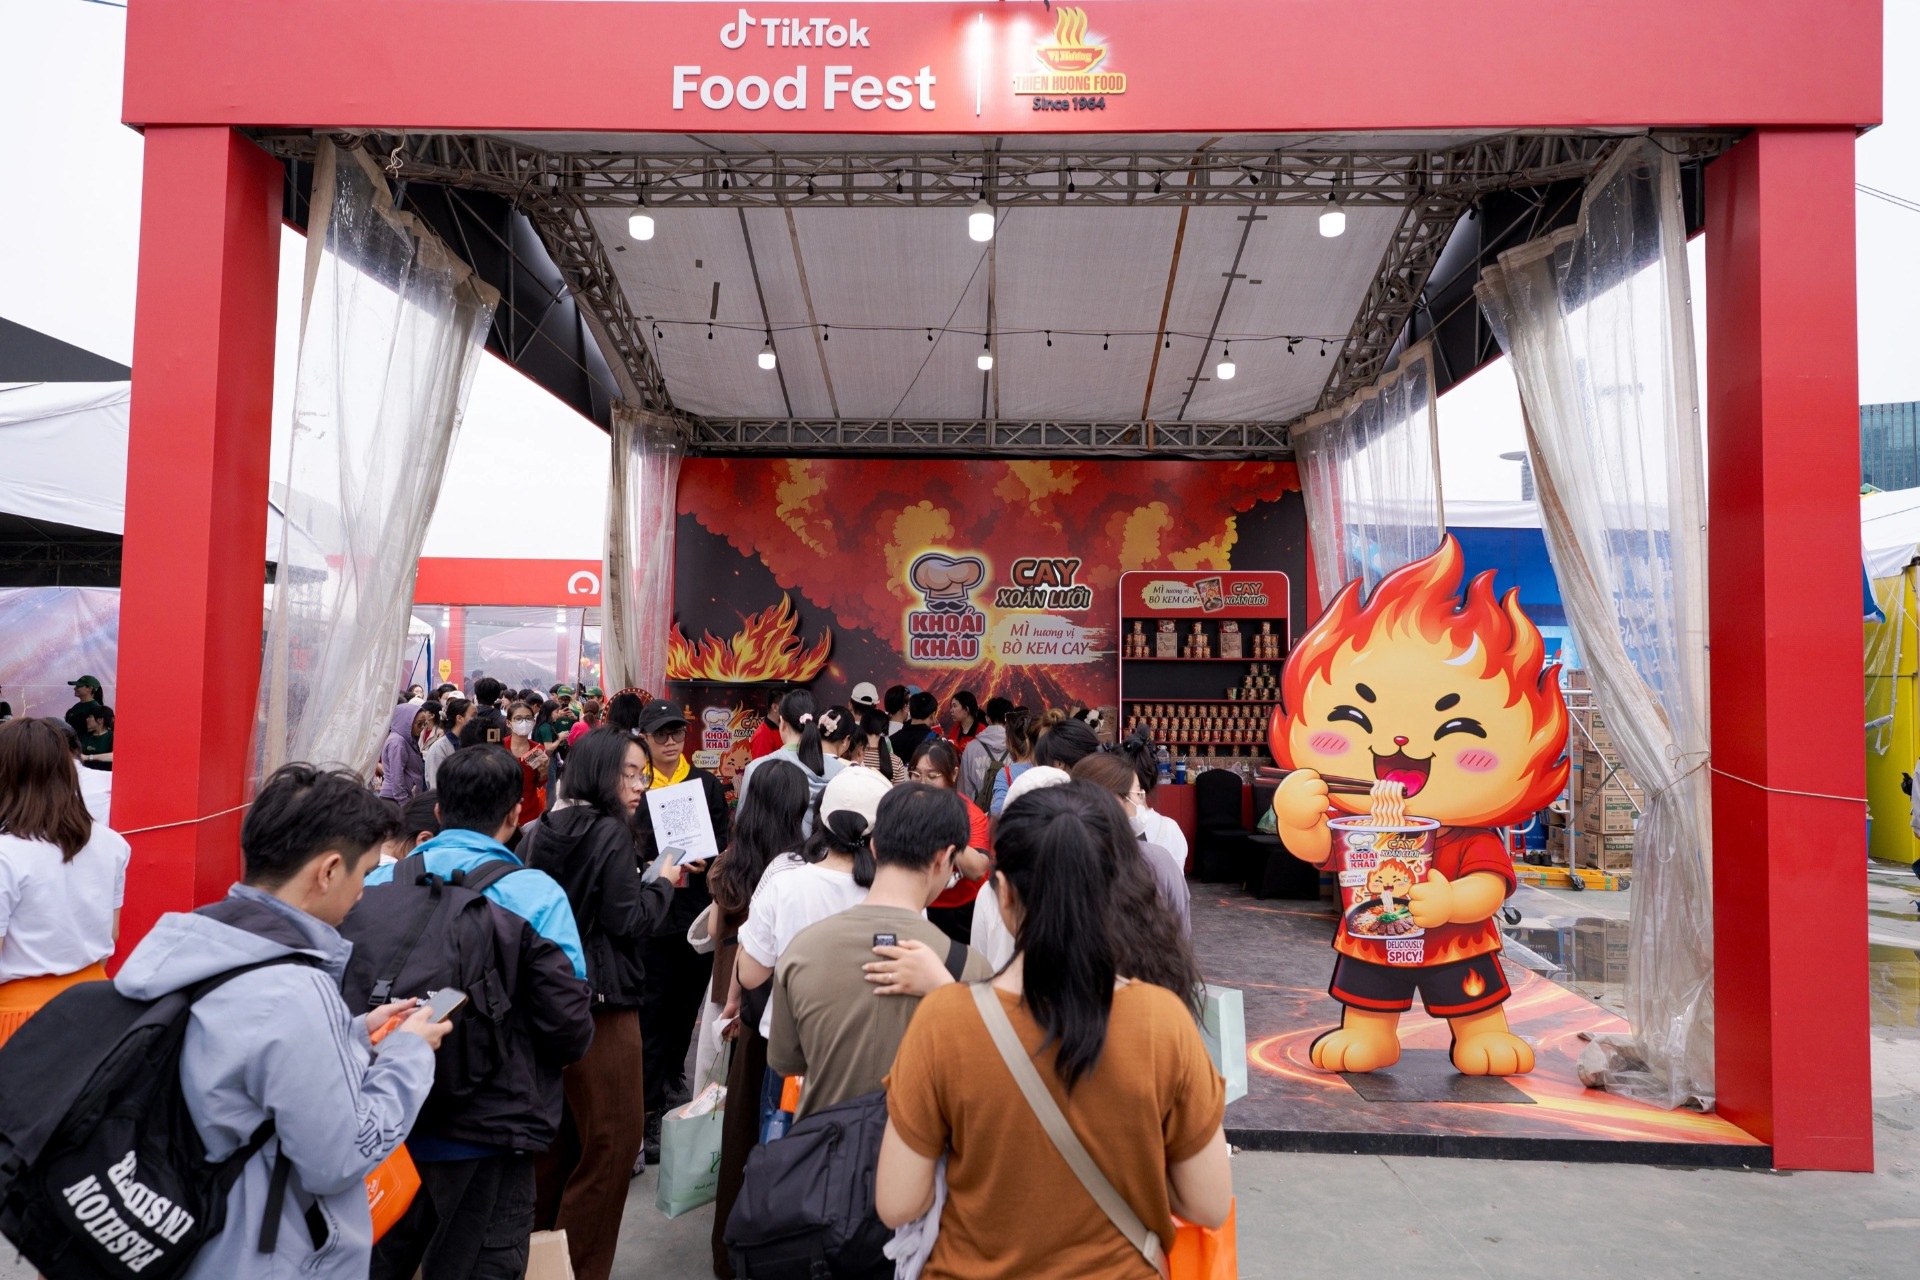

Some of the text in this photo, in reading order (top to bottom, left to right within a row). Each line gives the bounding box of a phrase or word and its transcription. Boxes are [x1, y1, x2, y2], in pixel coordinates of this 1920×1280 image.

[761, 17, 870, 48] TikTok
[672, 63, 936, 111] Food Fest
[1016, 75, 1124, 91] THIEN HUONG FOOD
[1033, 96, 1105, 111] Since 1964
[1013, 559, 1080, 587] CAY
[998, 587, 1092, 608] XOẮN LƯỠI
[1232, 583, 1262, 595] CAY
[1162, 595, 1180, 604] KEM
[1182, 595, 1197, 604] CAY
[911, 608, 984, 635] KHOÁI
[1033, 628, 1063, 639] hương
[1065, 627, 1075, 639] vị
[912, 632, 978, 658] KHẨU
[1001, 638, 1090, 656] BÒ KEM CAY
[1387, 839, 1415, 849] CAY
[1387, 940, 1423, 949] DELICIOUSLY
[1389, 951, 1422, 961] SPICY!
[62, 1174, 164, 1273] FASHION
